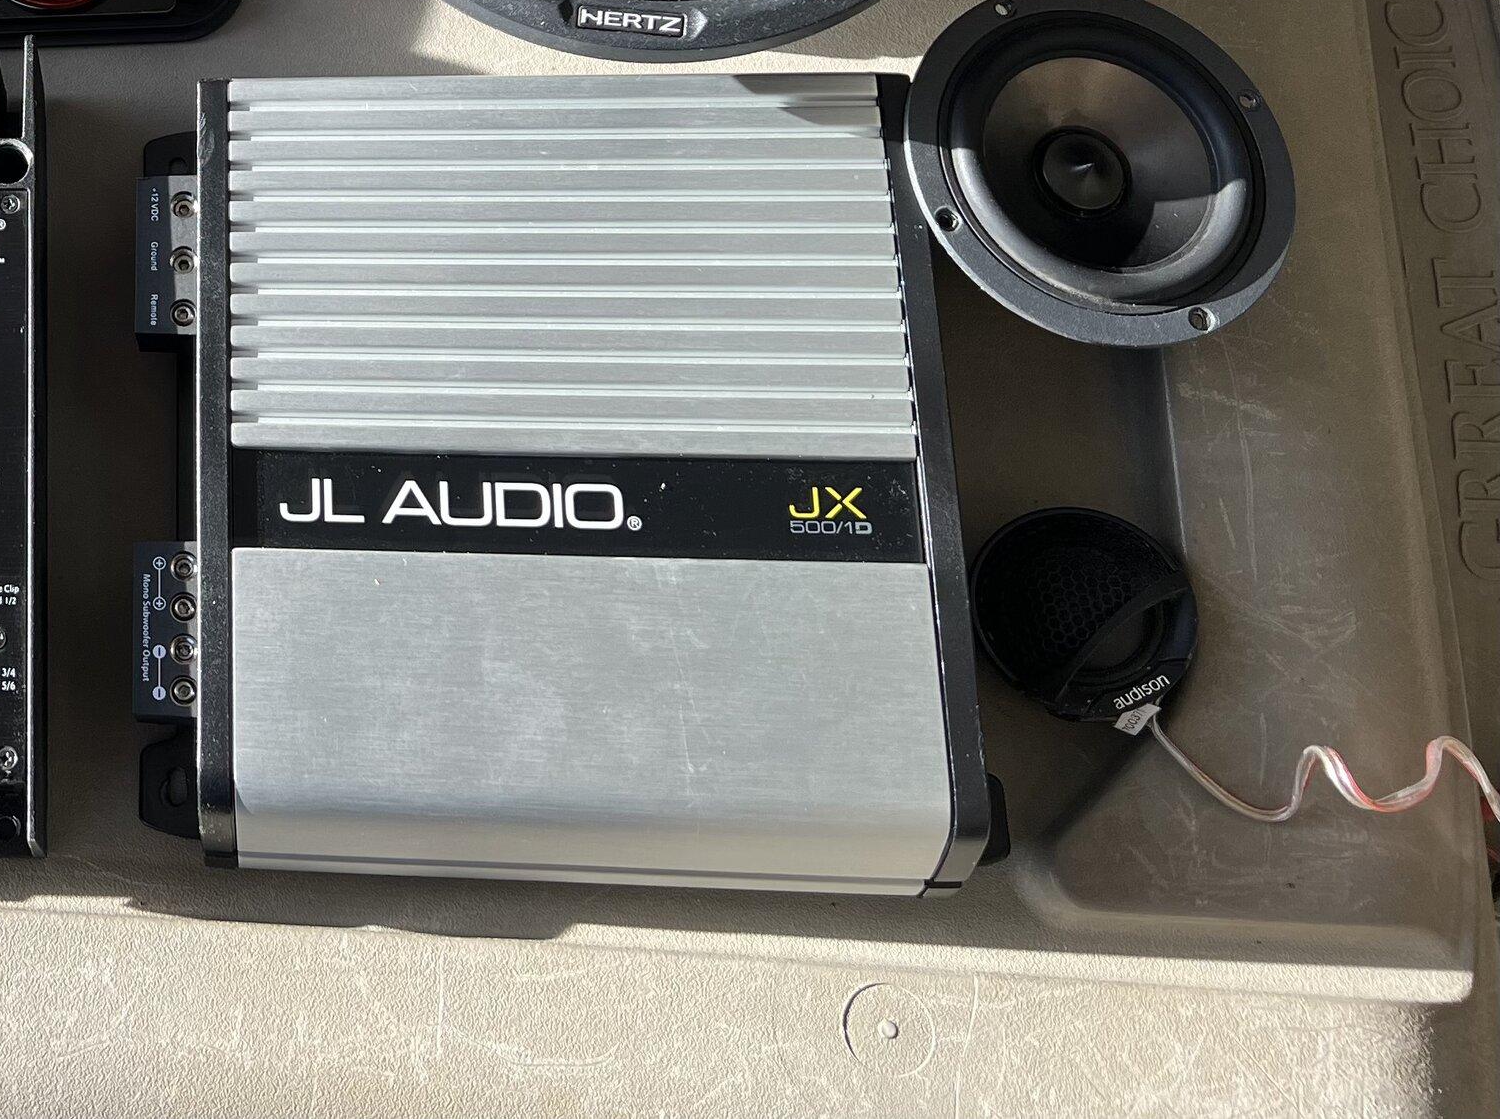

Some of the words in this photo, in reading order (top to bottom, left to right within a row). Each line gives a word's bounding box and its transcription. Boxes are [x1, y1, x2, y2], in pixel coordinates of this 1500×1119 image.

[581, 9, 682, 32] HERTZ
[151, 204, 159, 222] VDC
[150, 294, 158, 326] Remote
[279, 478, 365, 523] JL
[789, 487, 866, 518] JX
[790, 521, 872, 534] 500/1D
[2, 668, 16, 677] 3/4
[141, 650, 150, 681] Output
[2, 681, 16, 690] 5/6
[1114, 675, 1170, 709] audison
